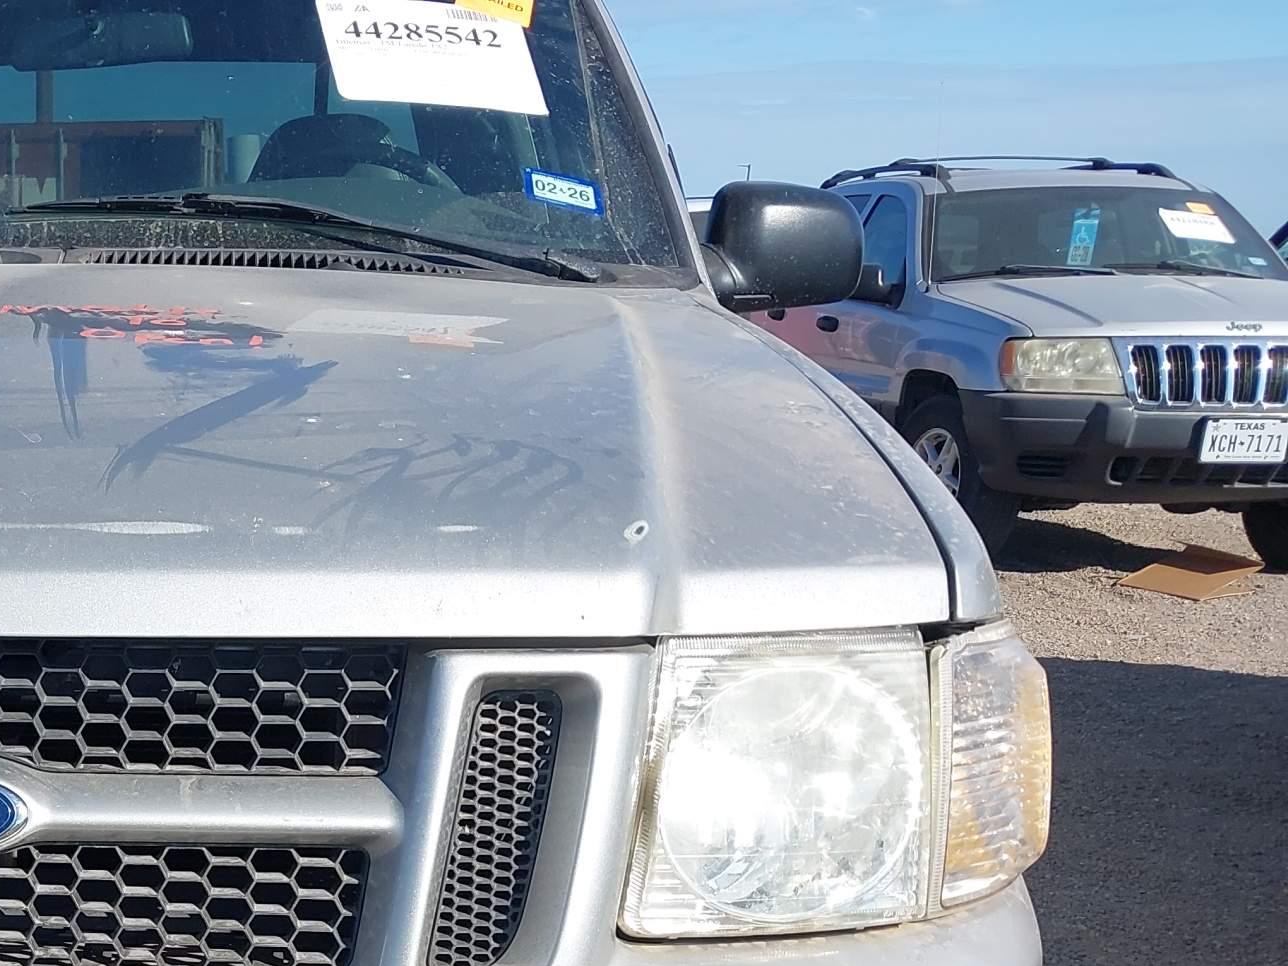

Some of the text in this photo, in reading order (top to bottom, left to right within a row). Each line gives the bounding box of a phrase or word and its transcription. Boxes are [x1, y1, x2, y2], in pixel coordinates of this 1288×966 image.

[344, 20, 502, 48] 44285542
[1225, 321, 1263, 333] Jeep
[1234, 422, 1266, 431] TEXAS
